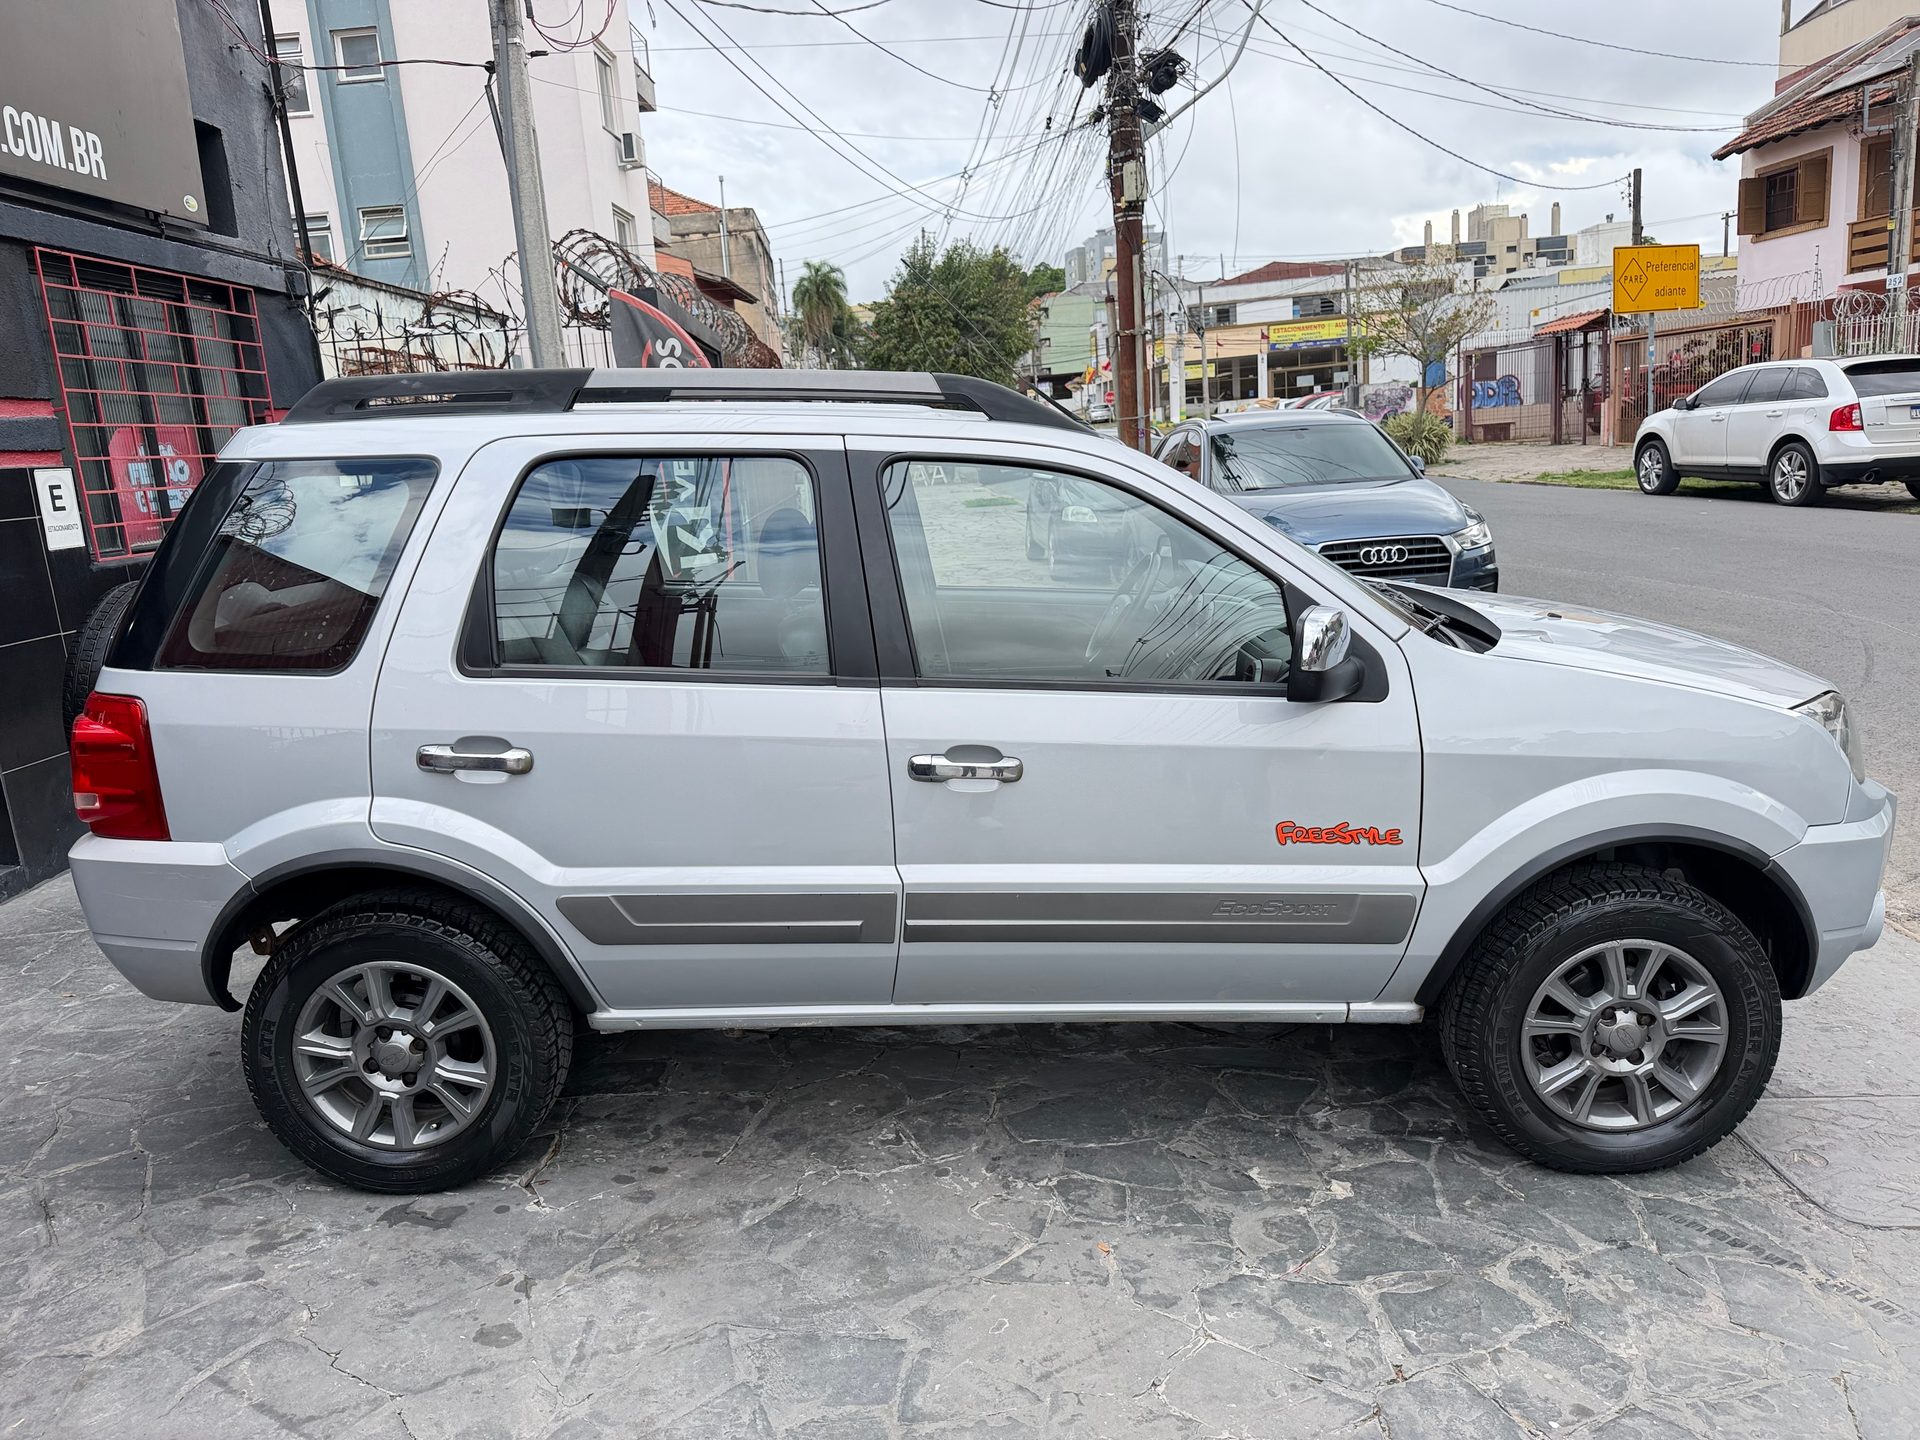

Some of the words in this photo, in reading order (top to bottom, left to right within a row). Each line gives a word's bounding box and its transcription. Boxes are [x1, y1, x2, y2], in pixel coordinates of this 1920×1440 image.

[1, 105, 107, 180] .COM.BR
[1646, 261, 1696, 272] Preferencial
[1623, 275, 1643, 284] PARE
[1888, 276, 1902, 287] 252
[1655, 286, 1686, 297] adiante
[1273, 323, 1326, 334] ESTACIONAMENTO
[48, 484, 66, 512] E
[47, 523, 79, 532] ESTACIONAMENTO
